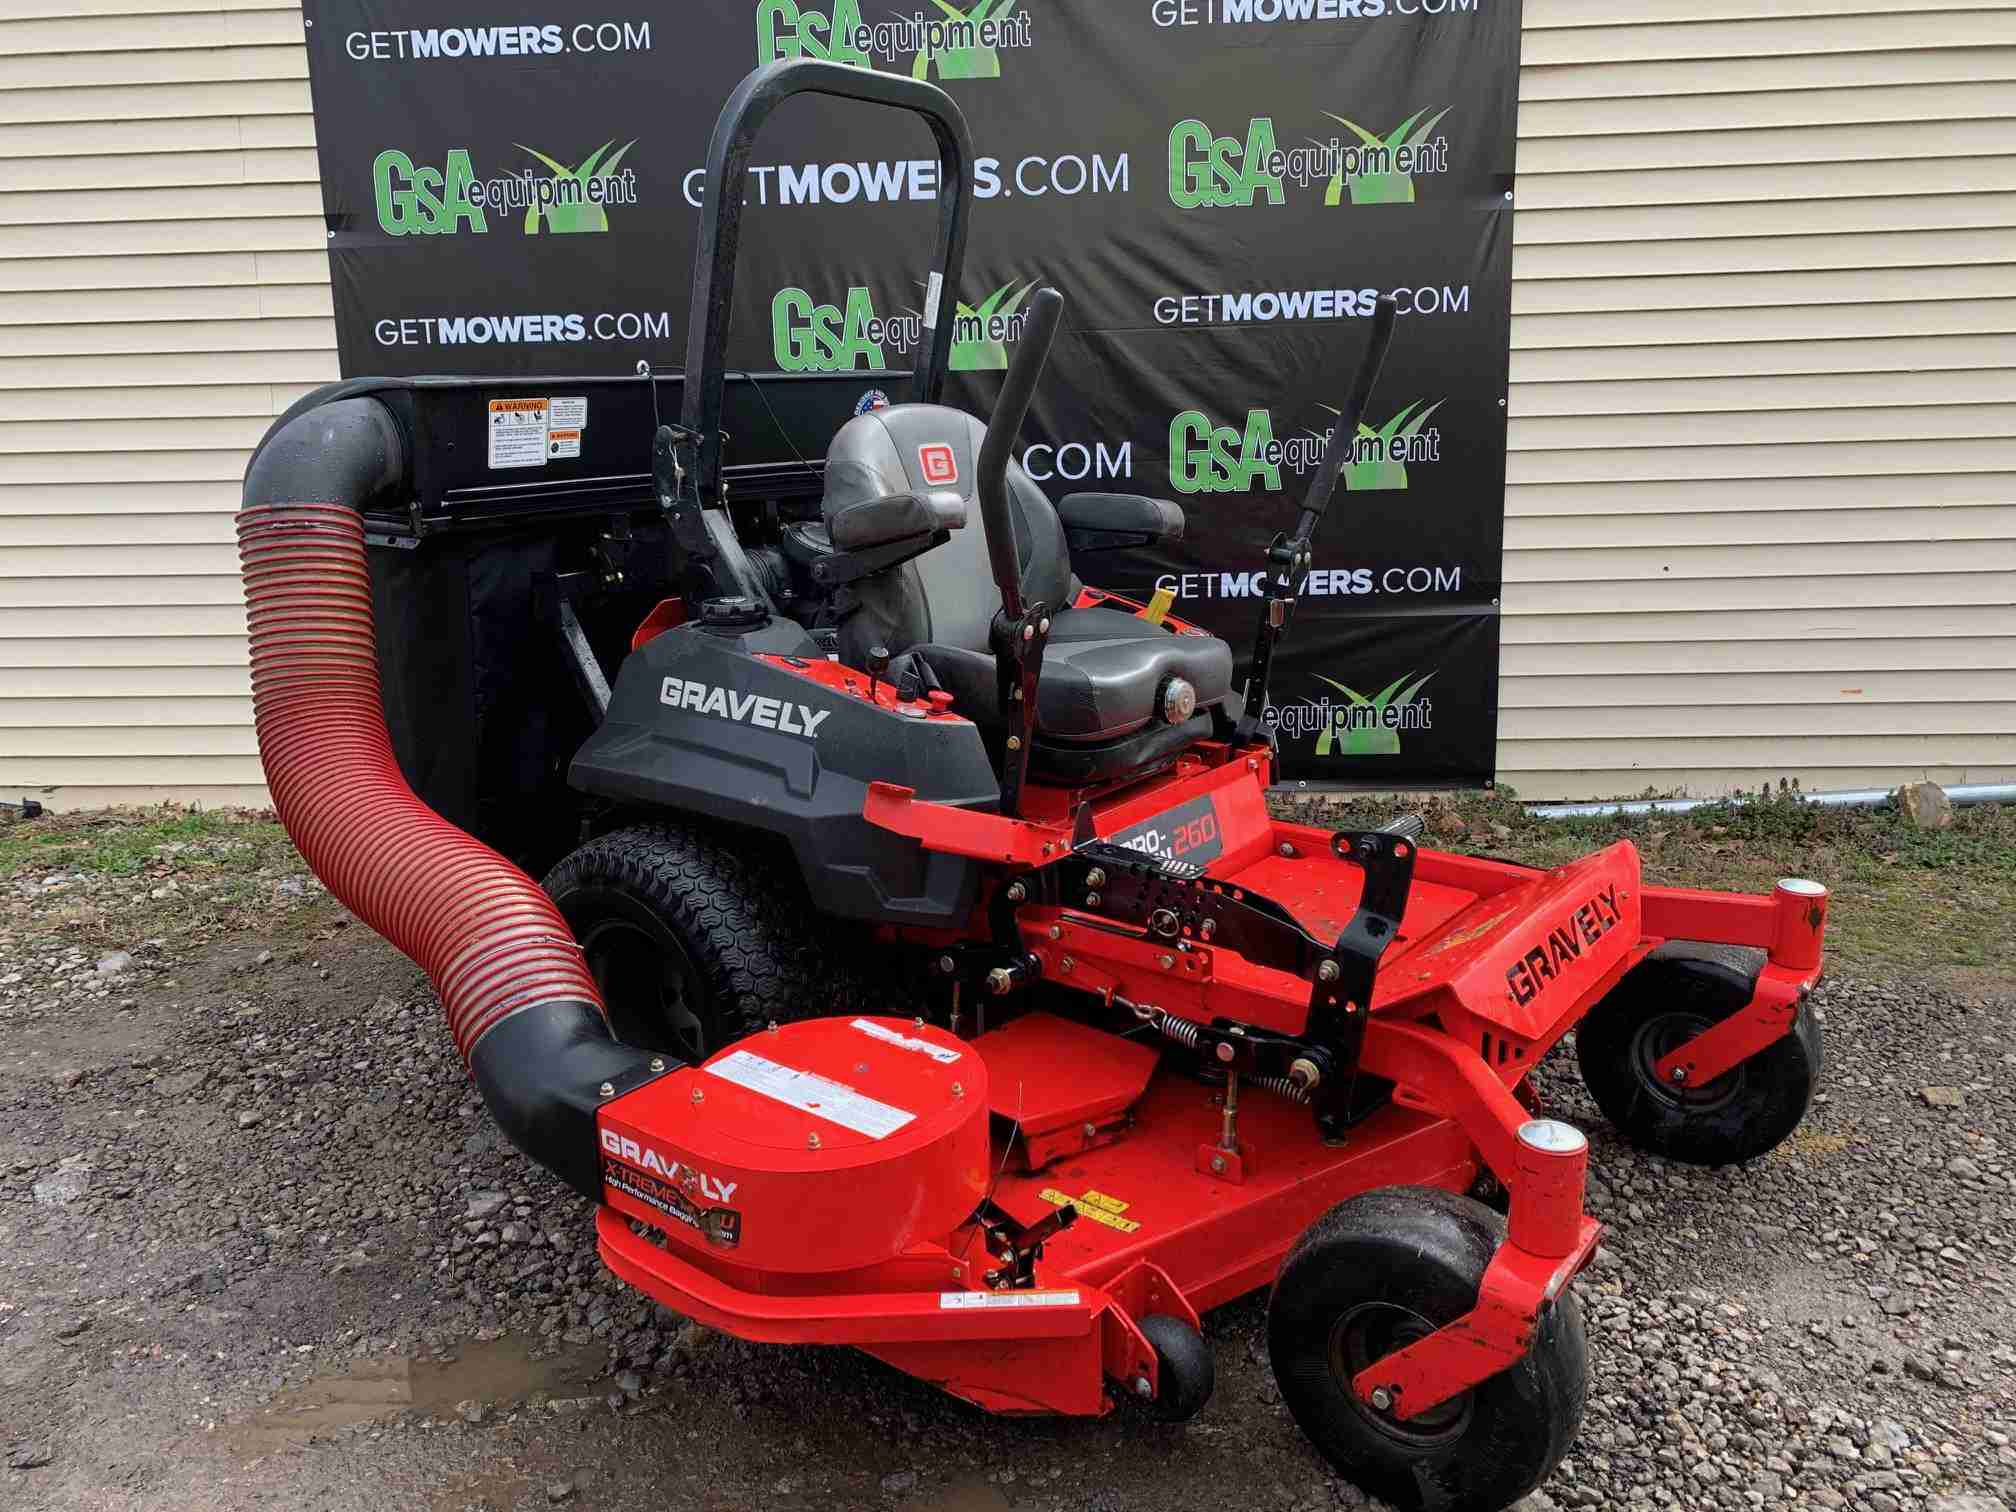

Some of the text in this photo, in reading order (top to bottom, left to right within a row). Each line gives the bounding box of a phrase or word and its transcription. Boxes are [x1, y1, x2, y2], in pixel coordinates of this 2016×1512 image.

[345, 21, 651, 60] GETMOWERS.COM
[682, 152, 1130, 208] GTMOWES.COM
[1153, 285, 1470, 325] GETMOWERSCOM
[374, 311, 671, 346] GETMOWERS.COM
[659, 676, 832, 738] GRAVELY
[1261, 696, 1433, 739] equipment
[1173, 813, 1216, 857] 260
[1505, 882, 1622, 1007] GRAVELY
[600, 1127, 738, 1204] GRAVLY
